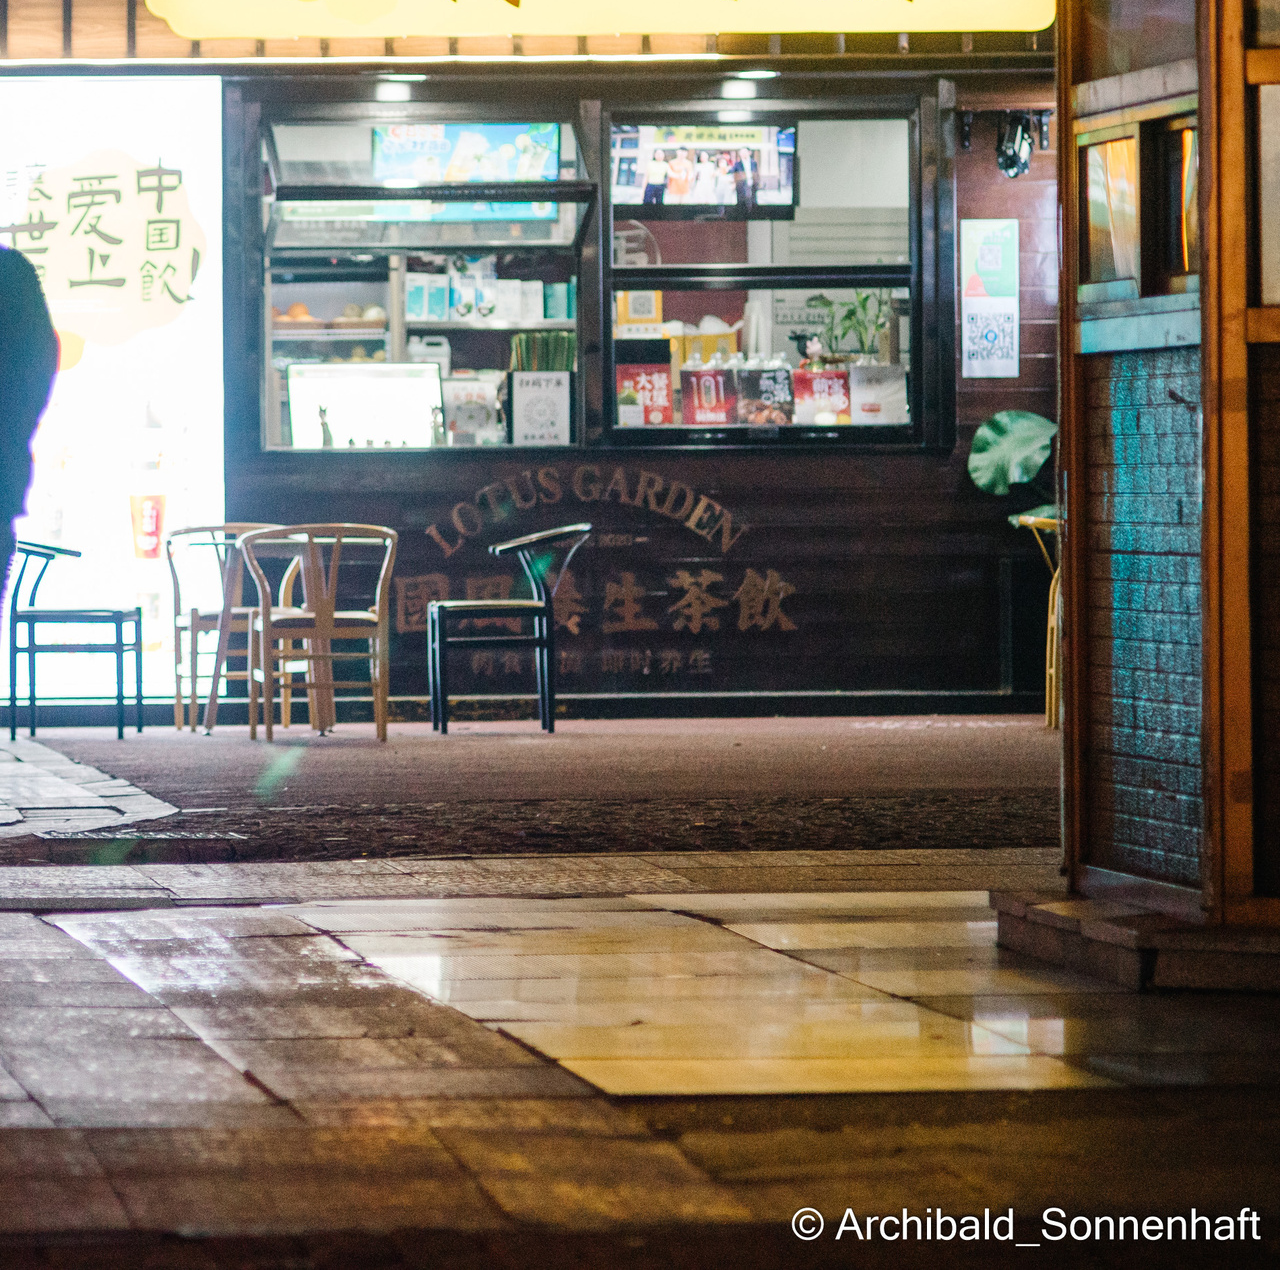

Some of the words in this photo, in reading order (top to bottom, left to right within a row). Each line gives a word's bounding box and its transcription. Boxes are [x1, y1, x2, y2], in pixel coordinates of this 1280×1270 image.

[67, 174, 127, 289] 爱上
[425, 467, 562, 559] LOTUS
[573, 463, 750, 554] GARDEN
